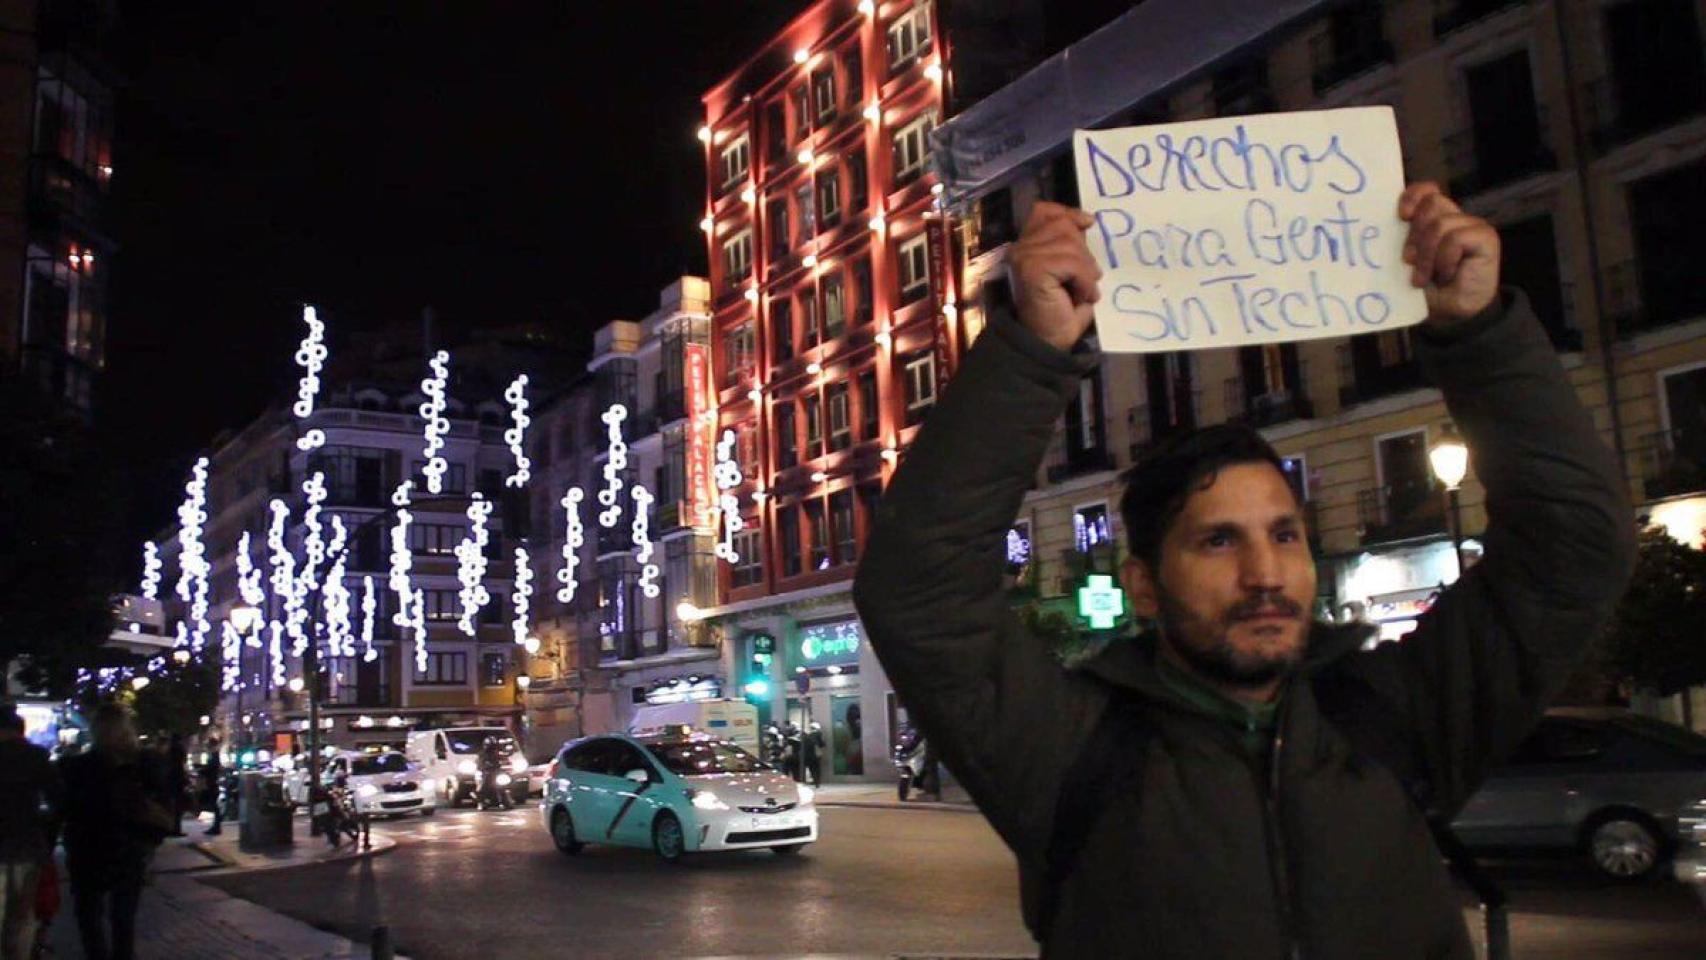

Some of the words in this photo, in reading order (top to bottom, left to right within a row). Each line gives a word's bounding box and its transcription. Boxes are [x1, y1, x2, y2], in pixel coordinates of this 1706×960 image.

[1086, 125, 1366, 198] Derechos
[1095, 209, 1235, 269] Para
[1246, 199, 1382, 269] Gente
[1113, 283, 1216, 341] Sin
[1200, 271, 1390, 334] Techo
